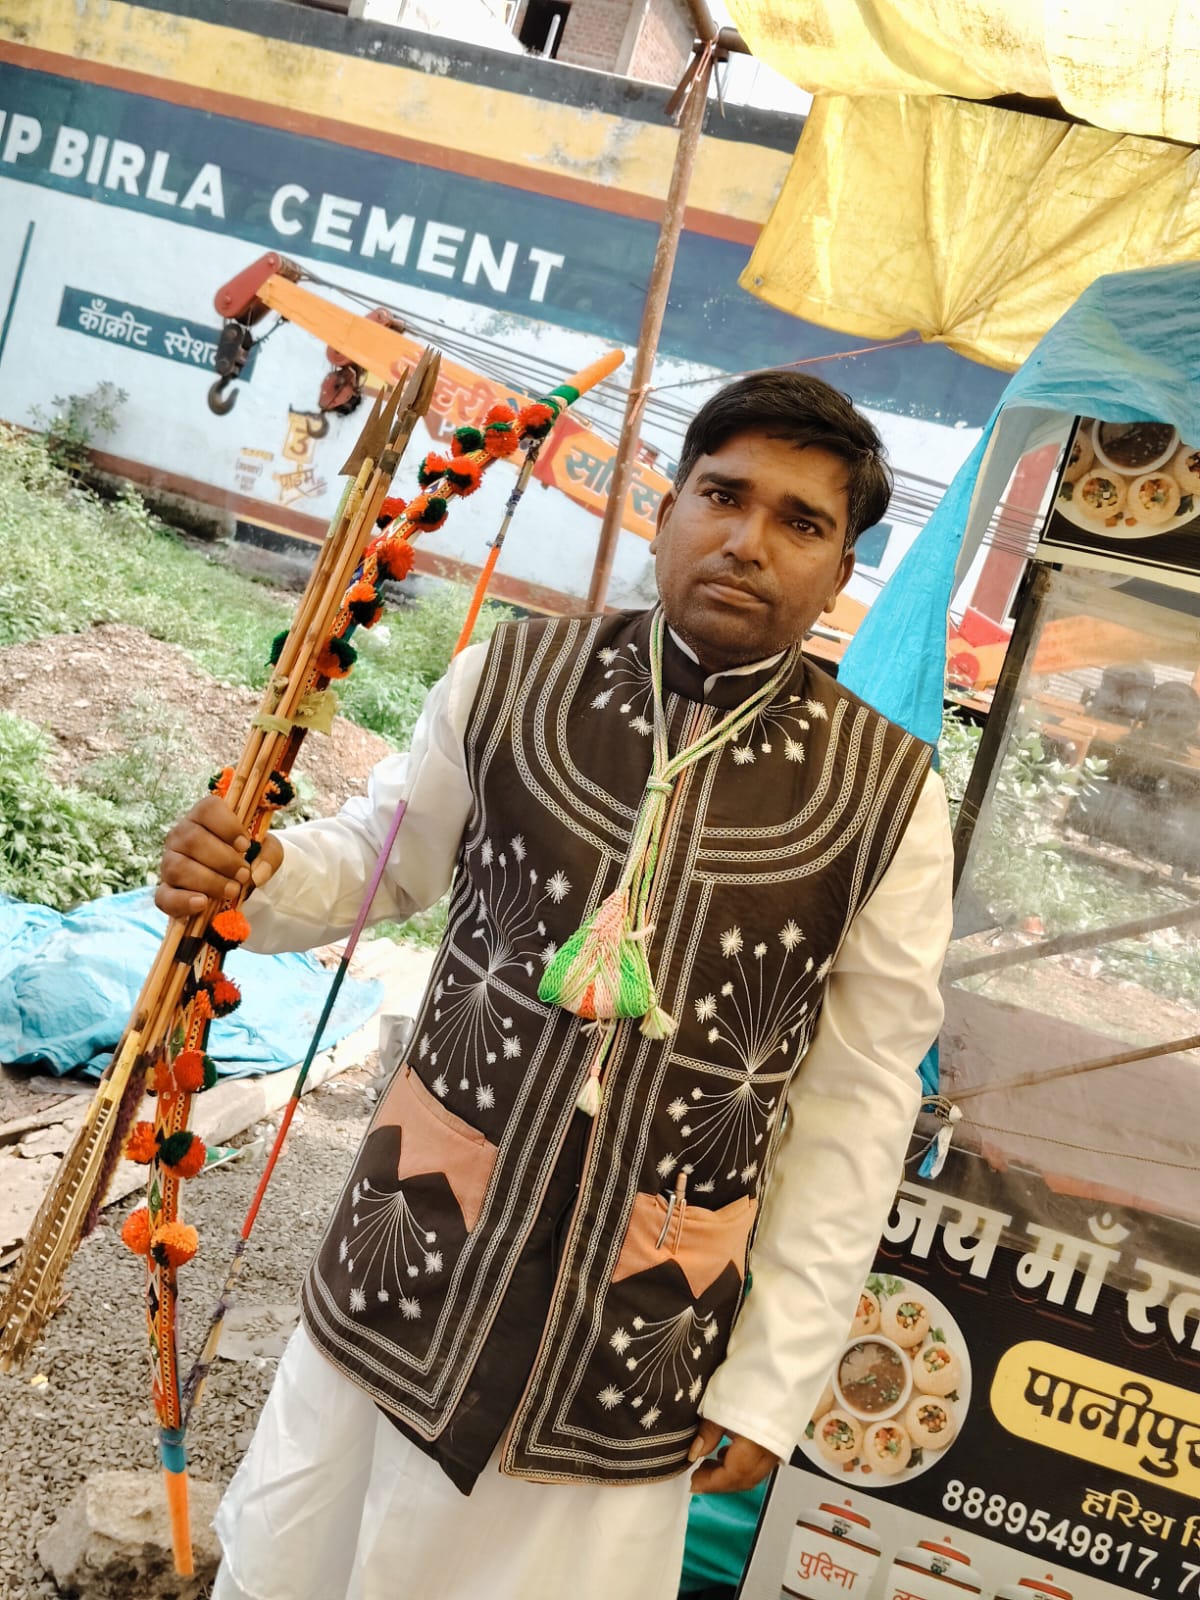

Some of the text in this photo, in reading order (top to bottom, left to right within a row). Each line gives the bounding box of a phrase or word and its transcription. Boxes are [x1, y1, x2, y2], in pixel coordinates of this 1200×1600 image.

[0, 109, 566, 303] P BIRLA CEMENT
[881, 1179, 1012, 1279] जय
[1016, 1211, 1130, 1316] माँ
[942, 1479, 1162, 1591] 8889549817,
[1081, 1487, 1177, 1540] हरिश
[796, 1551, 859, 1591] पुदिना
